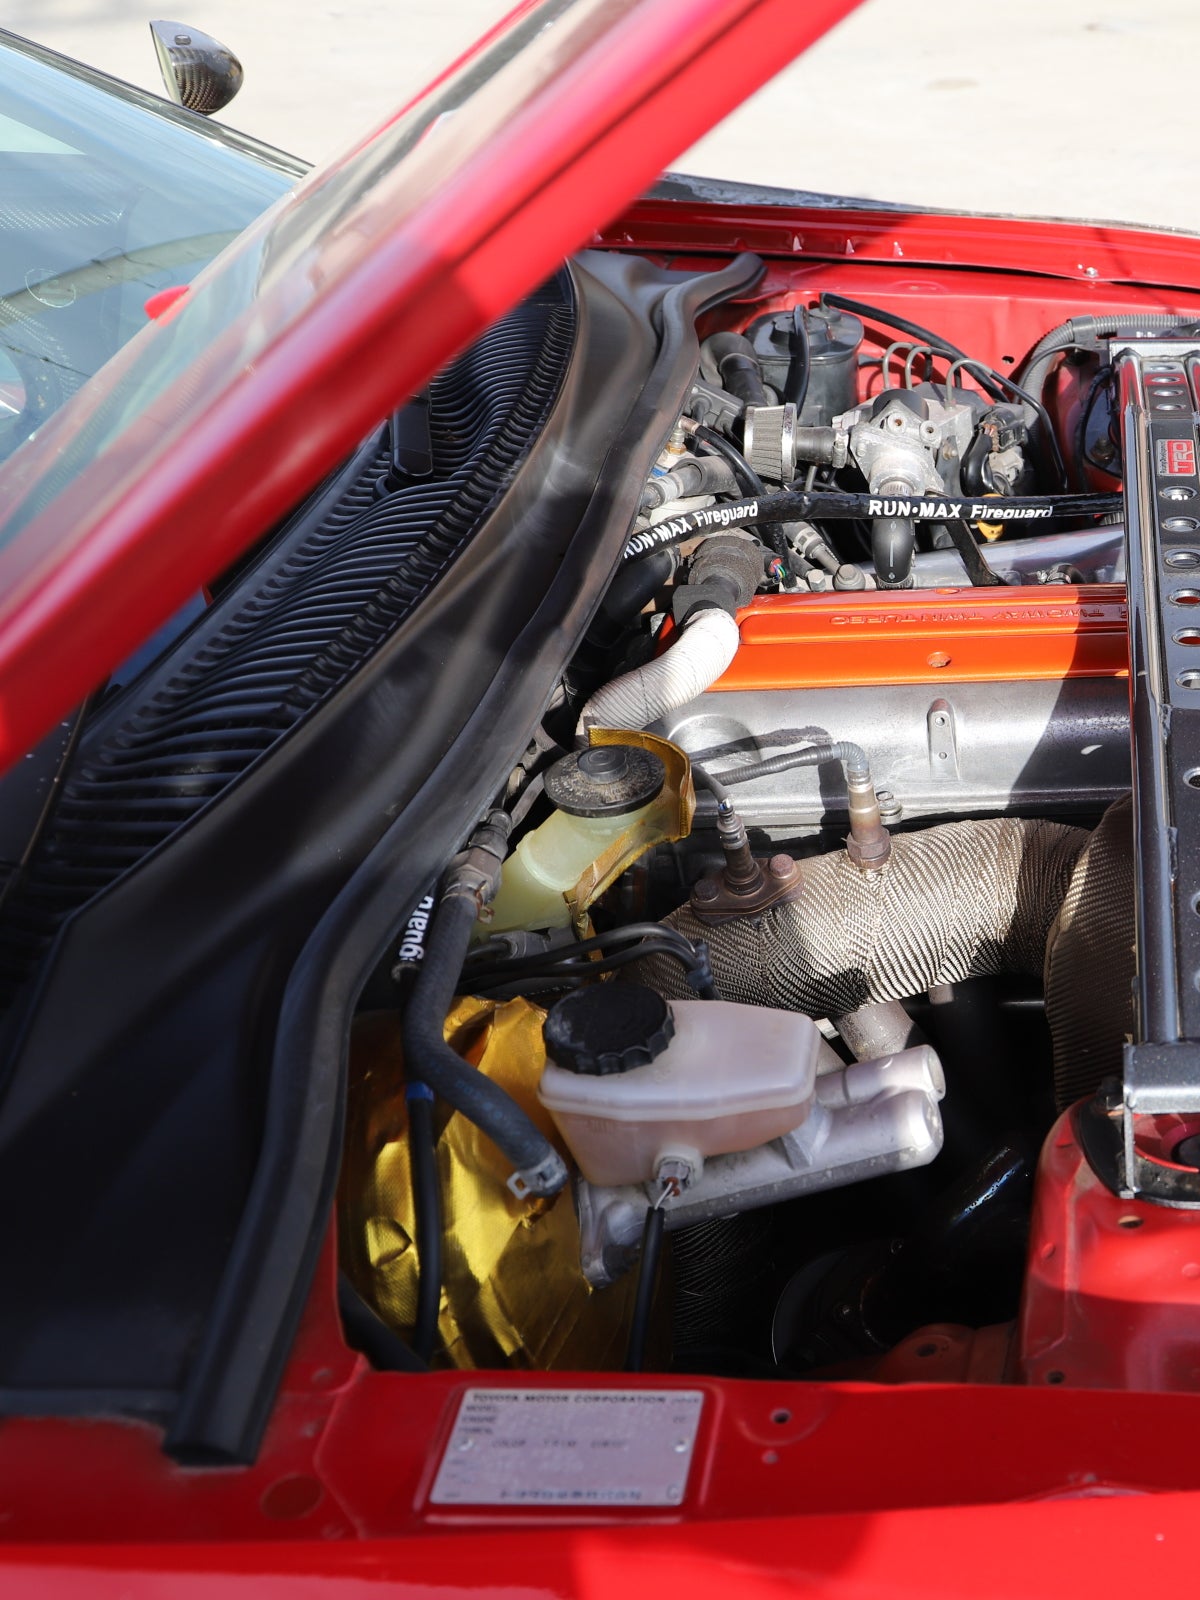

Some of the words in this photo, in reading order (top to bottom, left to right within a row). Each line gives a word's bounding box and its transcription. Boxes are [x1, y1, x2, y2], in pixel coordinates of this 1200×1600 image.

[1172, 442, 1194, 473] TRD
[692, 501, 758, 527] Fireguard
[969, 505, 1054, 519] Fireguard
[473, 1393, 518, 1402] TOYOTA
[525, 1394, 569, 1402] MOTOR
